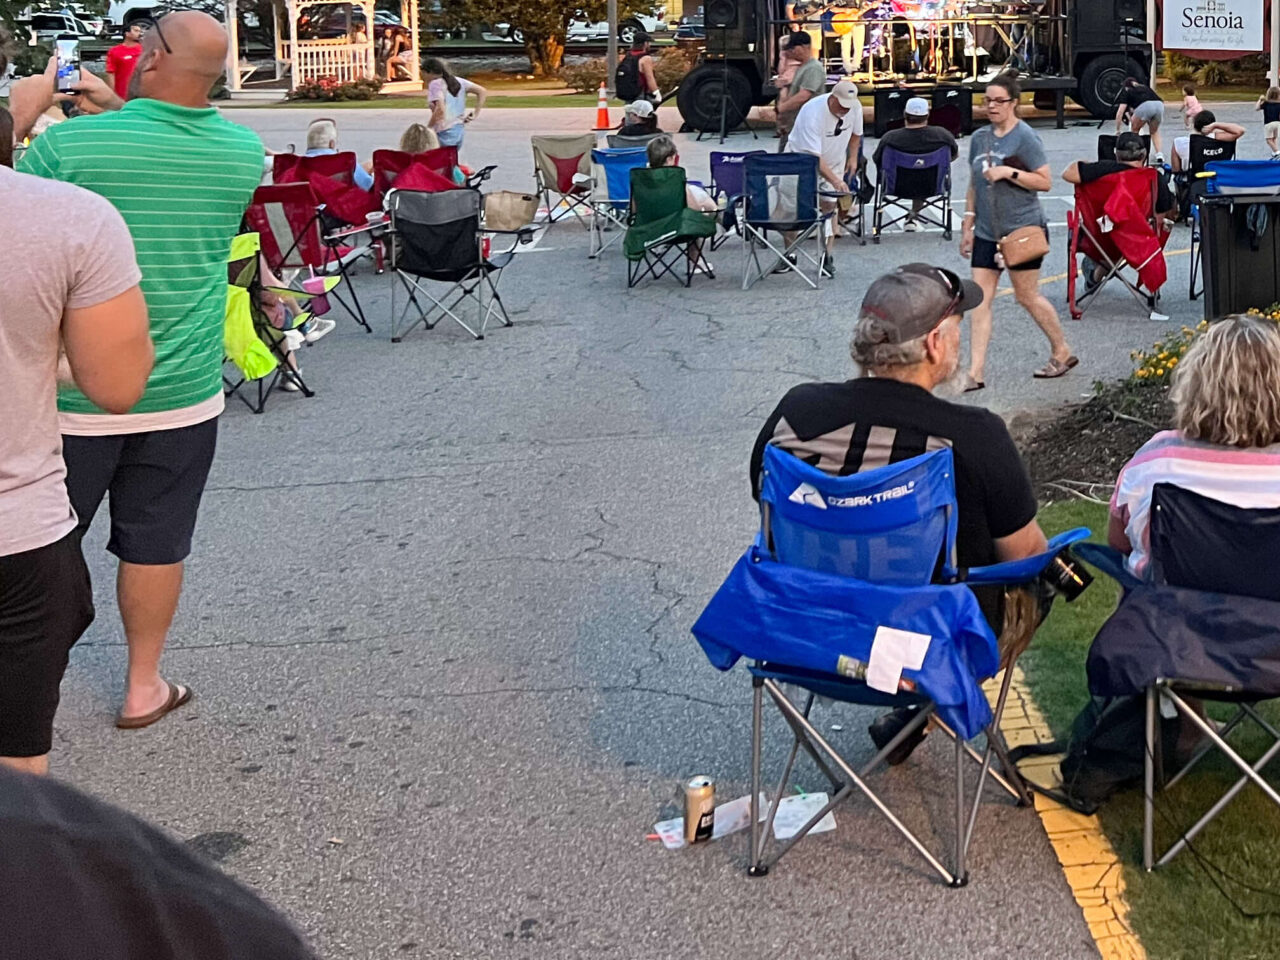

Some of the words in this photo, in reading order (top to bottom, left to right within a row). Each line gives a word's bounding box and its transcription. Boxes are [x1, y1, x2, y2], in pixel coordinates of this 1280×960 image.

[1181, 7, 1244, 30] Senoia
[827, 495, 873, 508] OZARK
[873, 484, 914, 504] TRAIL
